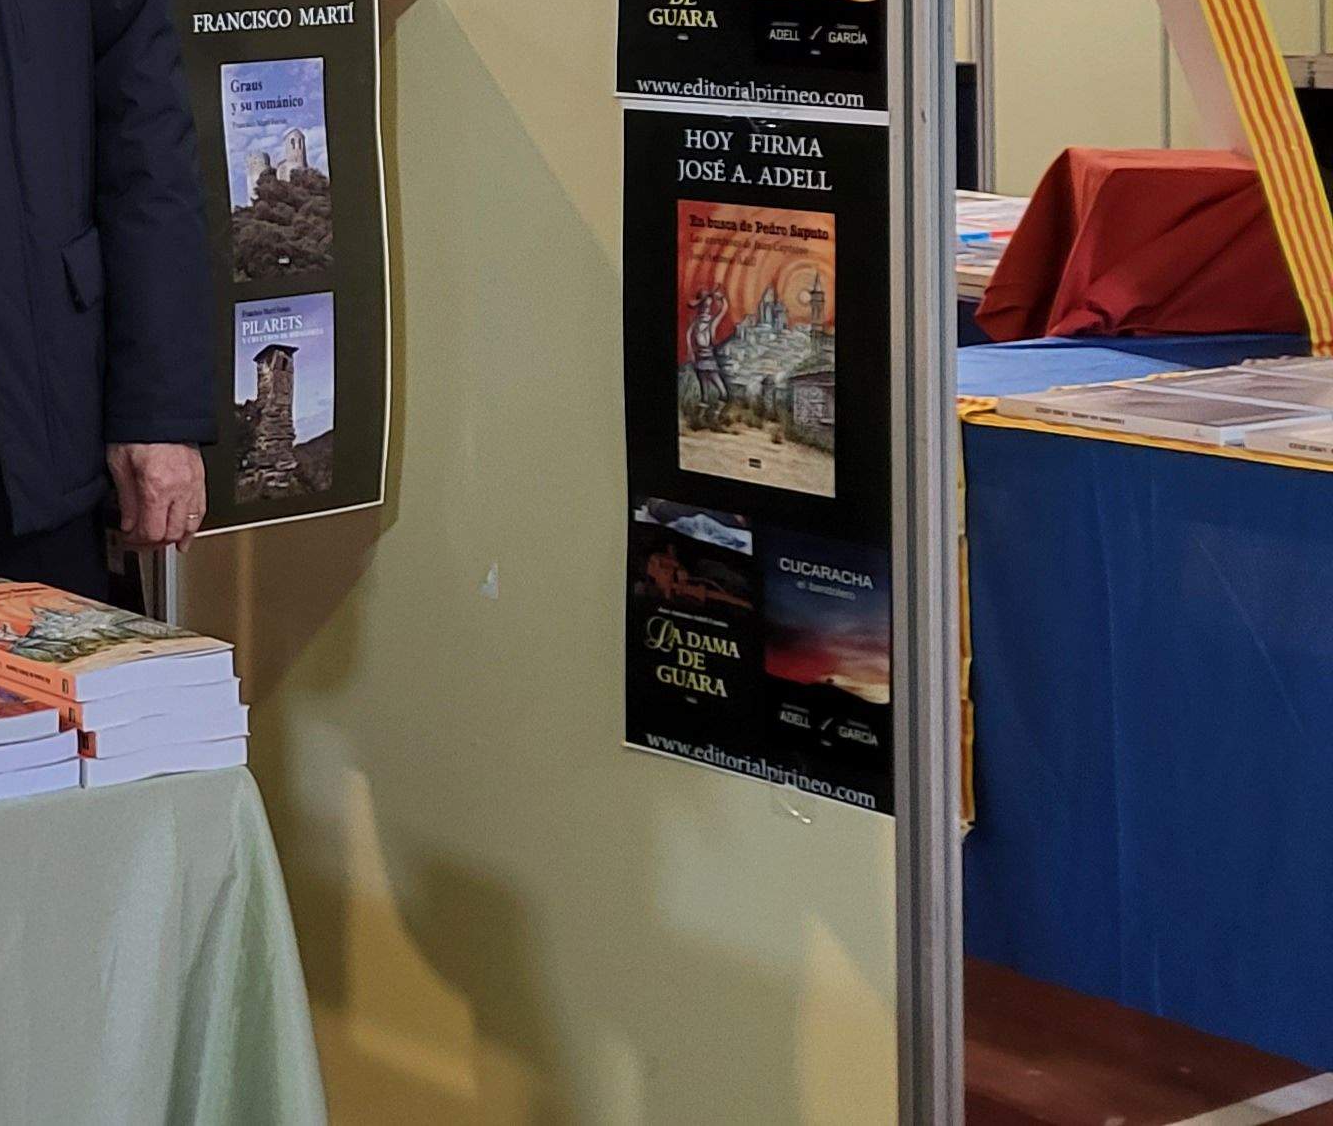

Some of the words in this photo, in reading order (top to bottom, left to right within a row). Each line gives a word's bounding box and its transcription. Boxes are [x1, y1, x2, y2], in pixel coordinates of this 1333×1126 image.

[193, 8, 292, 33] FRANCISCO
[299, 1, 355, 27] MARTÍ
[648, 9, 719, 28] GUARA
[769, 29, 801, 41] ADELL
[828, 30, 868, 44] GARCÍA
[230, 79, 263, 93] Graus
[636, 77, 865, 108] www.editorialpirineo.com
[685, 129, 734, 151] HOY
[749, 134, 824, 158] FIRMA
[677, 159, 726, 182] JOSÉ
[730, 164, 753, 184] A.
[758, 166, 833, 191] ADELL
[689, 215, 705, 227] En
[707, 216, 737, 231] busca
[739, 220, 753, 233] de
[755, 221, 787, 235] Pedro
[790, 225, 829, 241] Saputo
[242, 315, 303, 336] PILARETS
[779, 557, 874, 590] CUCARACHA
[687, 631, 741, 659] DAMA
[677, 649, 706, 671] DE
[656, 665, 729, 698] GUARA
[780, 710, 811, 729] ADELL
[837, 725, 879, 747] GARCÍA
[645, 732, 876, 809] www.editorialpirineo.com
